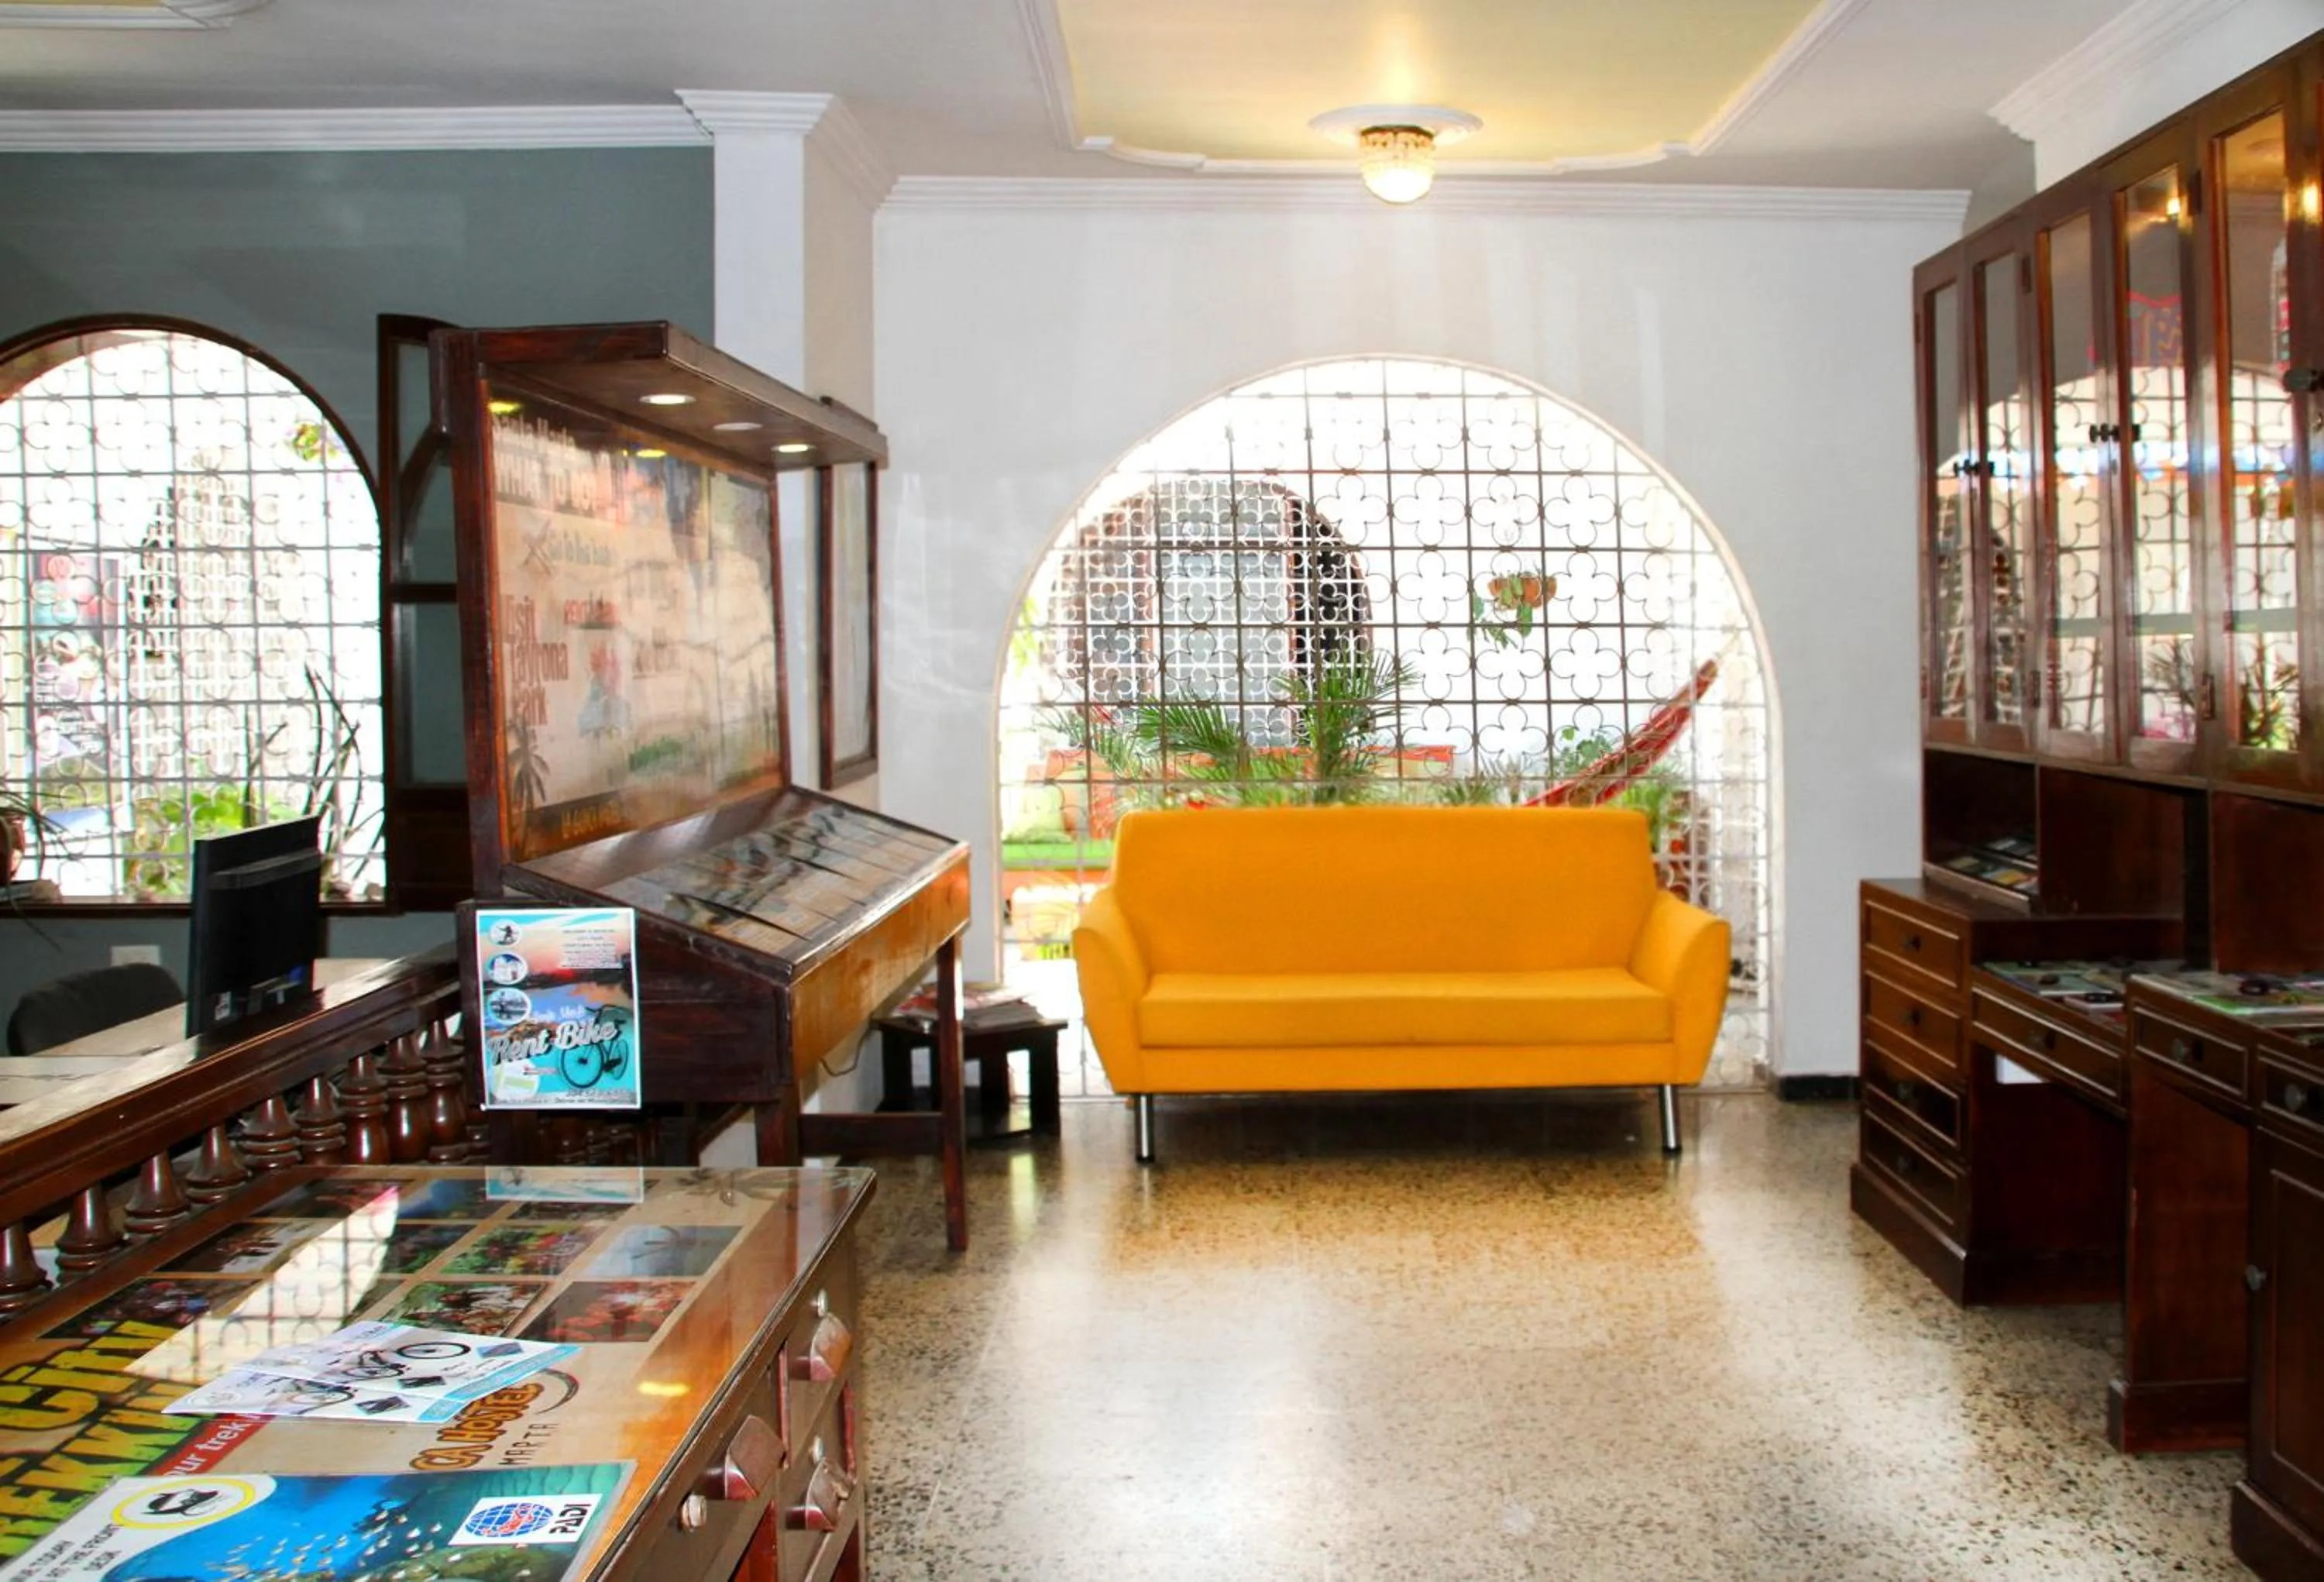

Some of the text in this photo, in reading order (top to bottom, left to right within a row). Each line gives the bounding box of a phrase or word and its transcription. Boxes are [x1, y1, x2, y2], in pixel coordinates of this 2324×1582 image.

[488, 1020, 619, 1064] Rent Bike
[437, 1382, 544, 1443] HOSTEL
[195, 1422, 253, 1450] trek
[497, 1422, 559, 1465] MARTA
[548, 1503, 592, 1534] PADI
